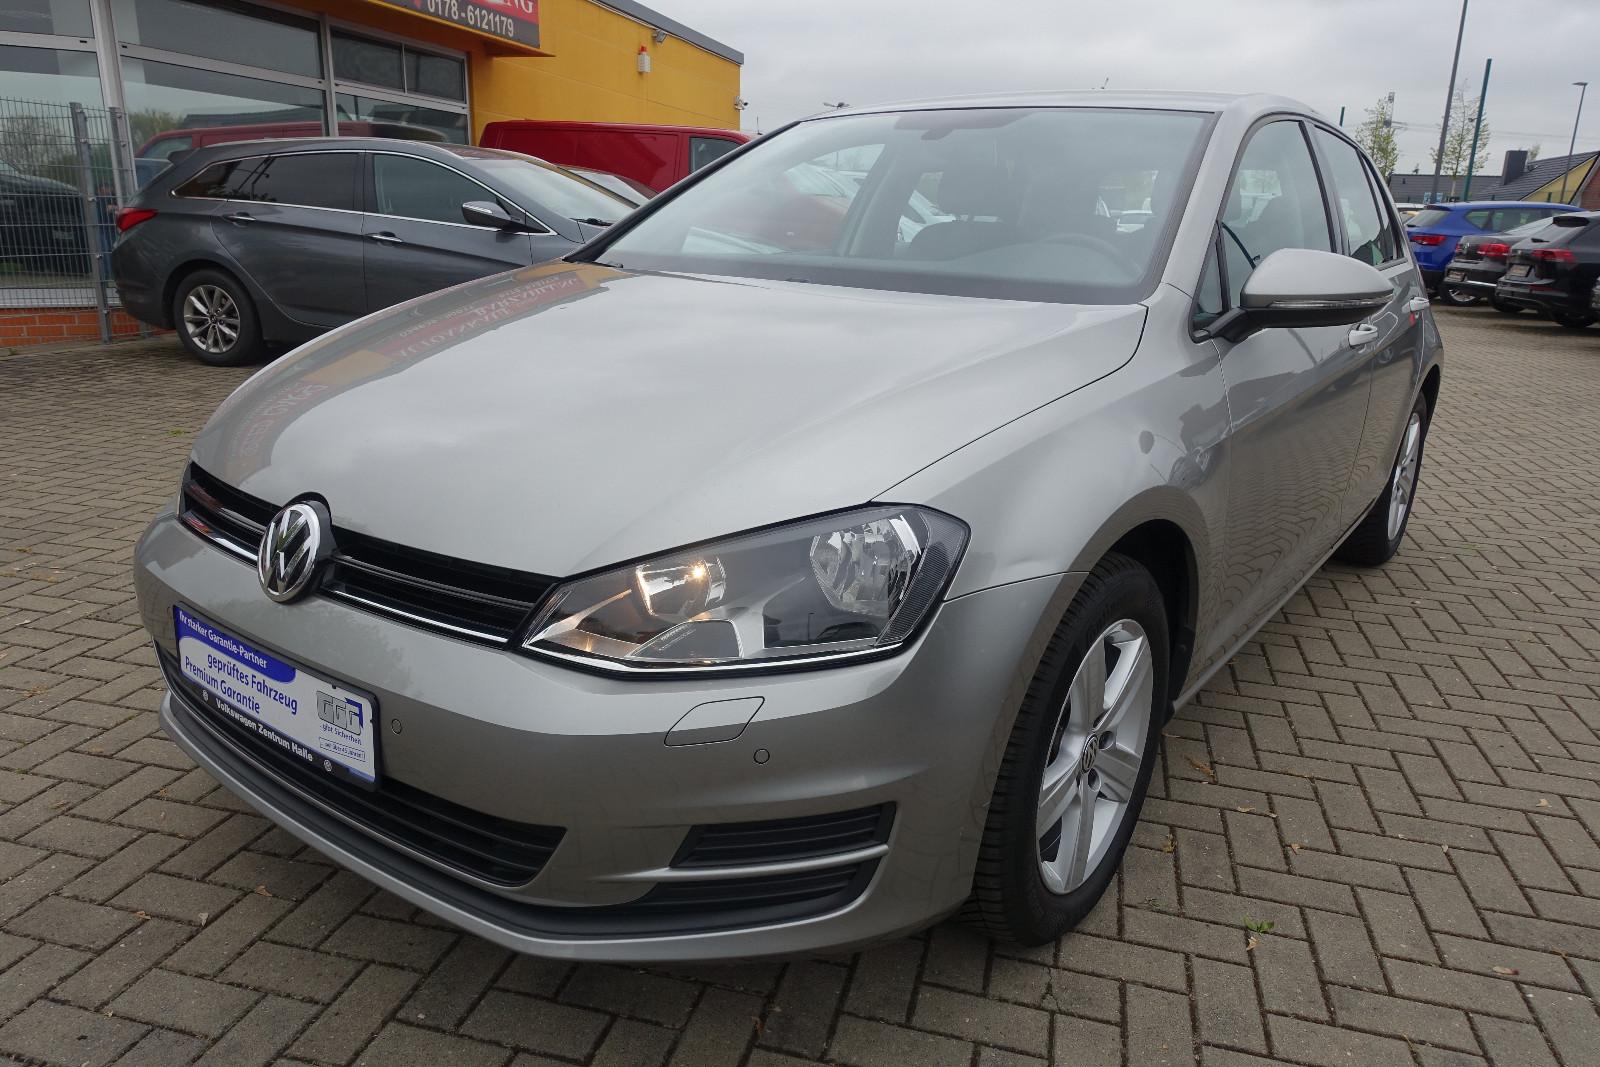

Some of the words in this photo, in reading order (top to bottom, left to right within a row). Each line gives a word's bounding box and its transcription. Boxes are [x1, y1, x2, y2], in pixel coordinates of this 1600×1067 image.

[188, 617, 208, 638] starker
[208, 629, 267, 669] Garantie-Partner
[185, 655, 220, 690] Premium
[220, 679, 260, 714] Garantie
[207, 654, 250, 687] geprüftes
[251, 673, 298, 715] Fahrzeug
[215, 697, 257, 731] Volkswagen
[257, 723, 291, 750] Zentrum
[291, 742, 313, 762] Halle
